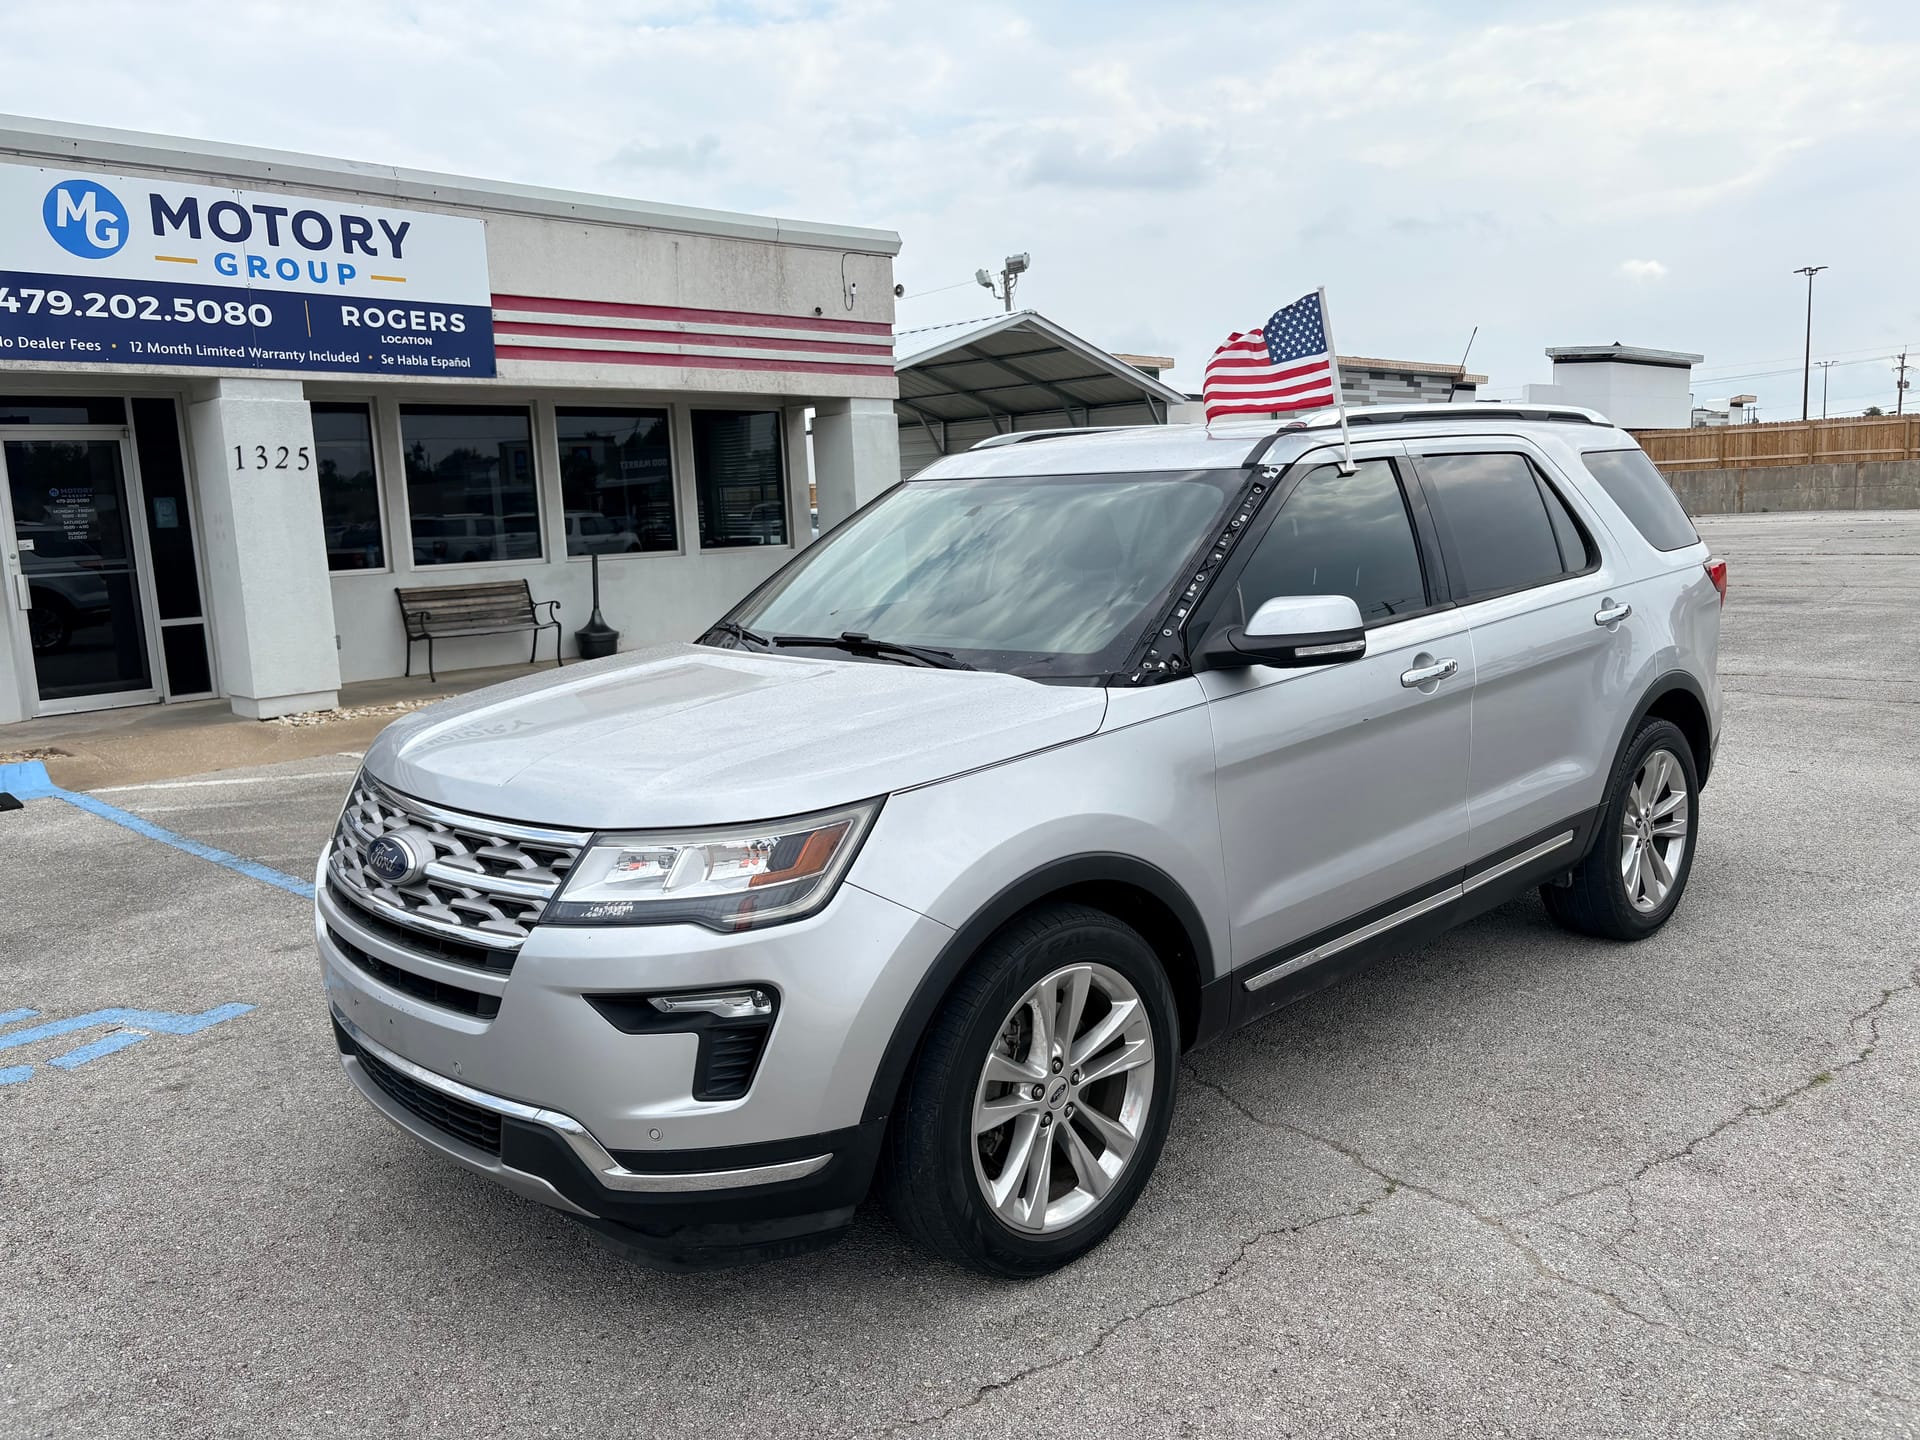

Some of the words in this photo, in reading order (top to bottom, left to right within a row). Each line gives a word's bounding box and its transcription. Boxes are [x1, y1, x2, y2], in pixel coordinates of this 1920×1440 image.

[57, 188, 119, 249] MG
[149, 193, 410, 259] MOTORY
[214, 252, 356, 285] GROUP
[0, 287, 273, 327] 479.202.5080
[341, 305, 466, 333] ROGERS
[18, 336, 66, 350] Dealer
[70, 338, 101, 351] Fees
[129, 341, 143, 353] 12
[147, 342, 192, 355] Month
[196, 344, 245, 358] Limited
[248, 347, 305, 363] Warranty
[309, 350, 360, 363] Included
[381, 353, 394, 365] Se
[397, 355, 429, 366] Habla
[431, 356, 471, 369] Español
[381, 335, 433, 346] LOCATION
[233, 445, 310, 471] 1325
[370, 841, 399, 872] Ford
